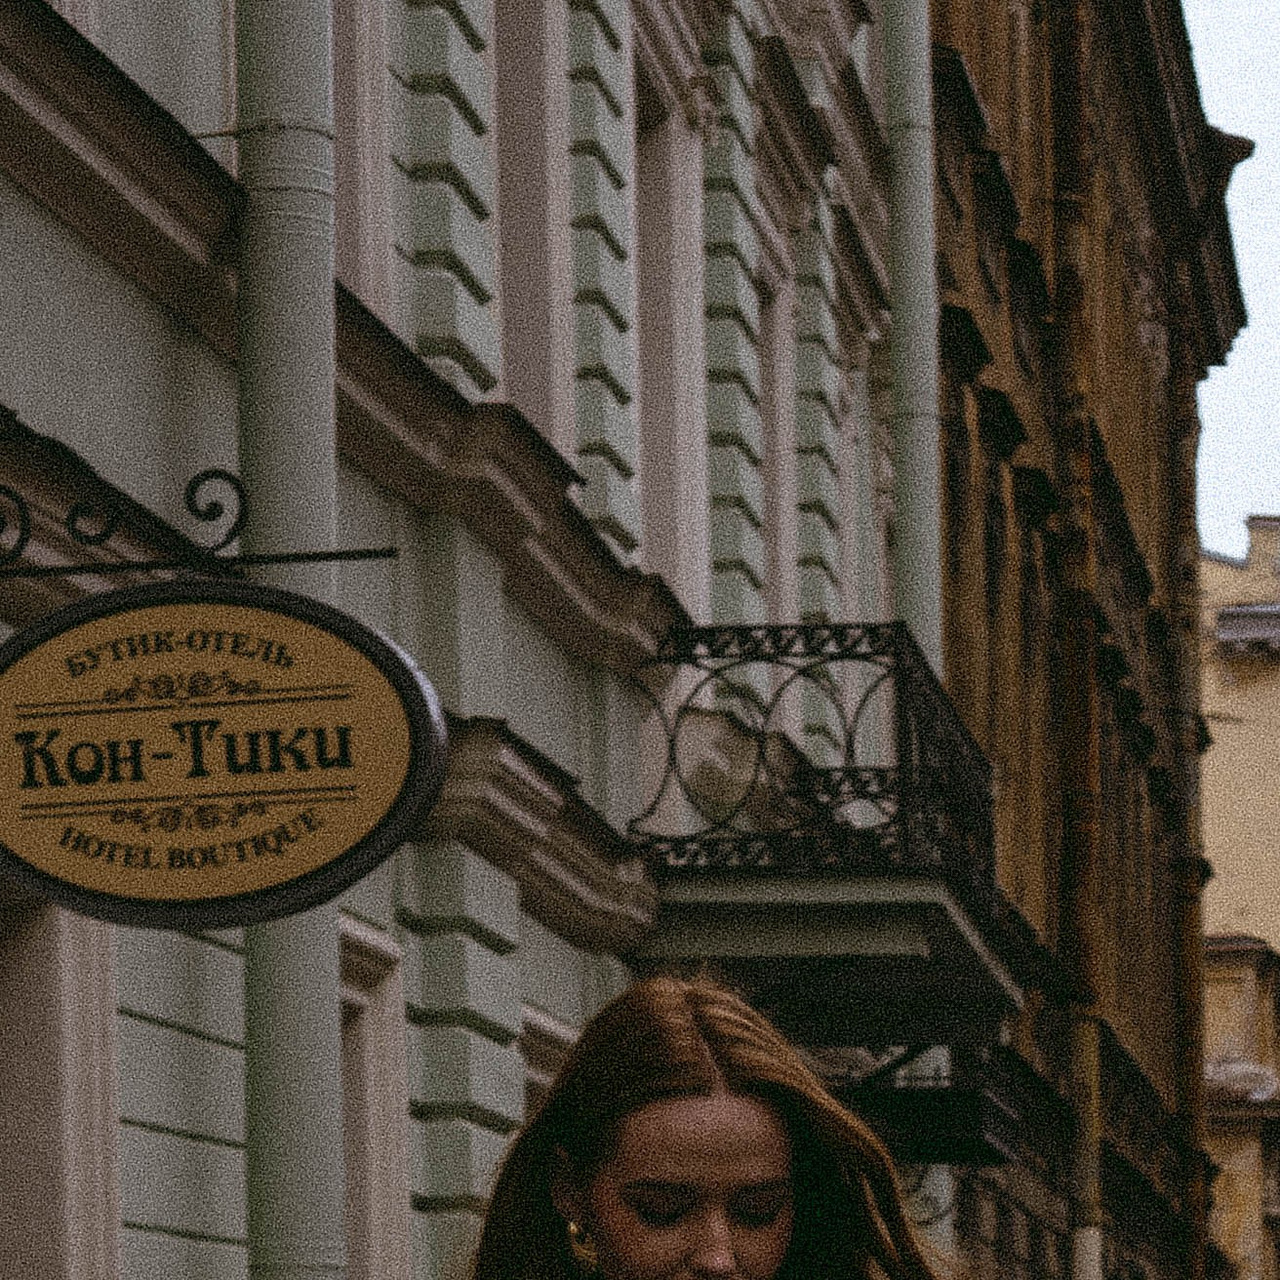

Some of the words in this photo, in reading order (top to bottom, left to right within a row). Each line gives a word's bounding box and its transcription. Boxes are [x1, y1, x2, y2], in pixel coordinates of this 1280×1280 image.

[66, 630, 294, 678] БУТИК-ОТЕЛЬ
[15, 720, 353, 789] Кон-Тики
[60, 827, 162, 869] HOTEL
[168, 808, 323, 870] BOUTIQUE
